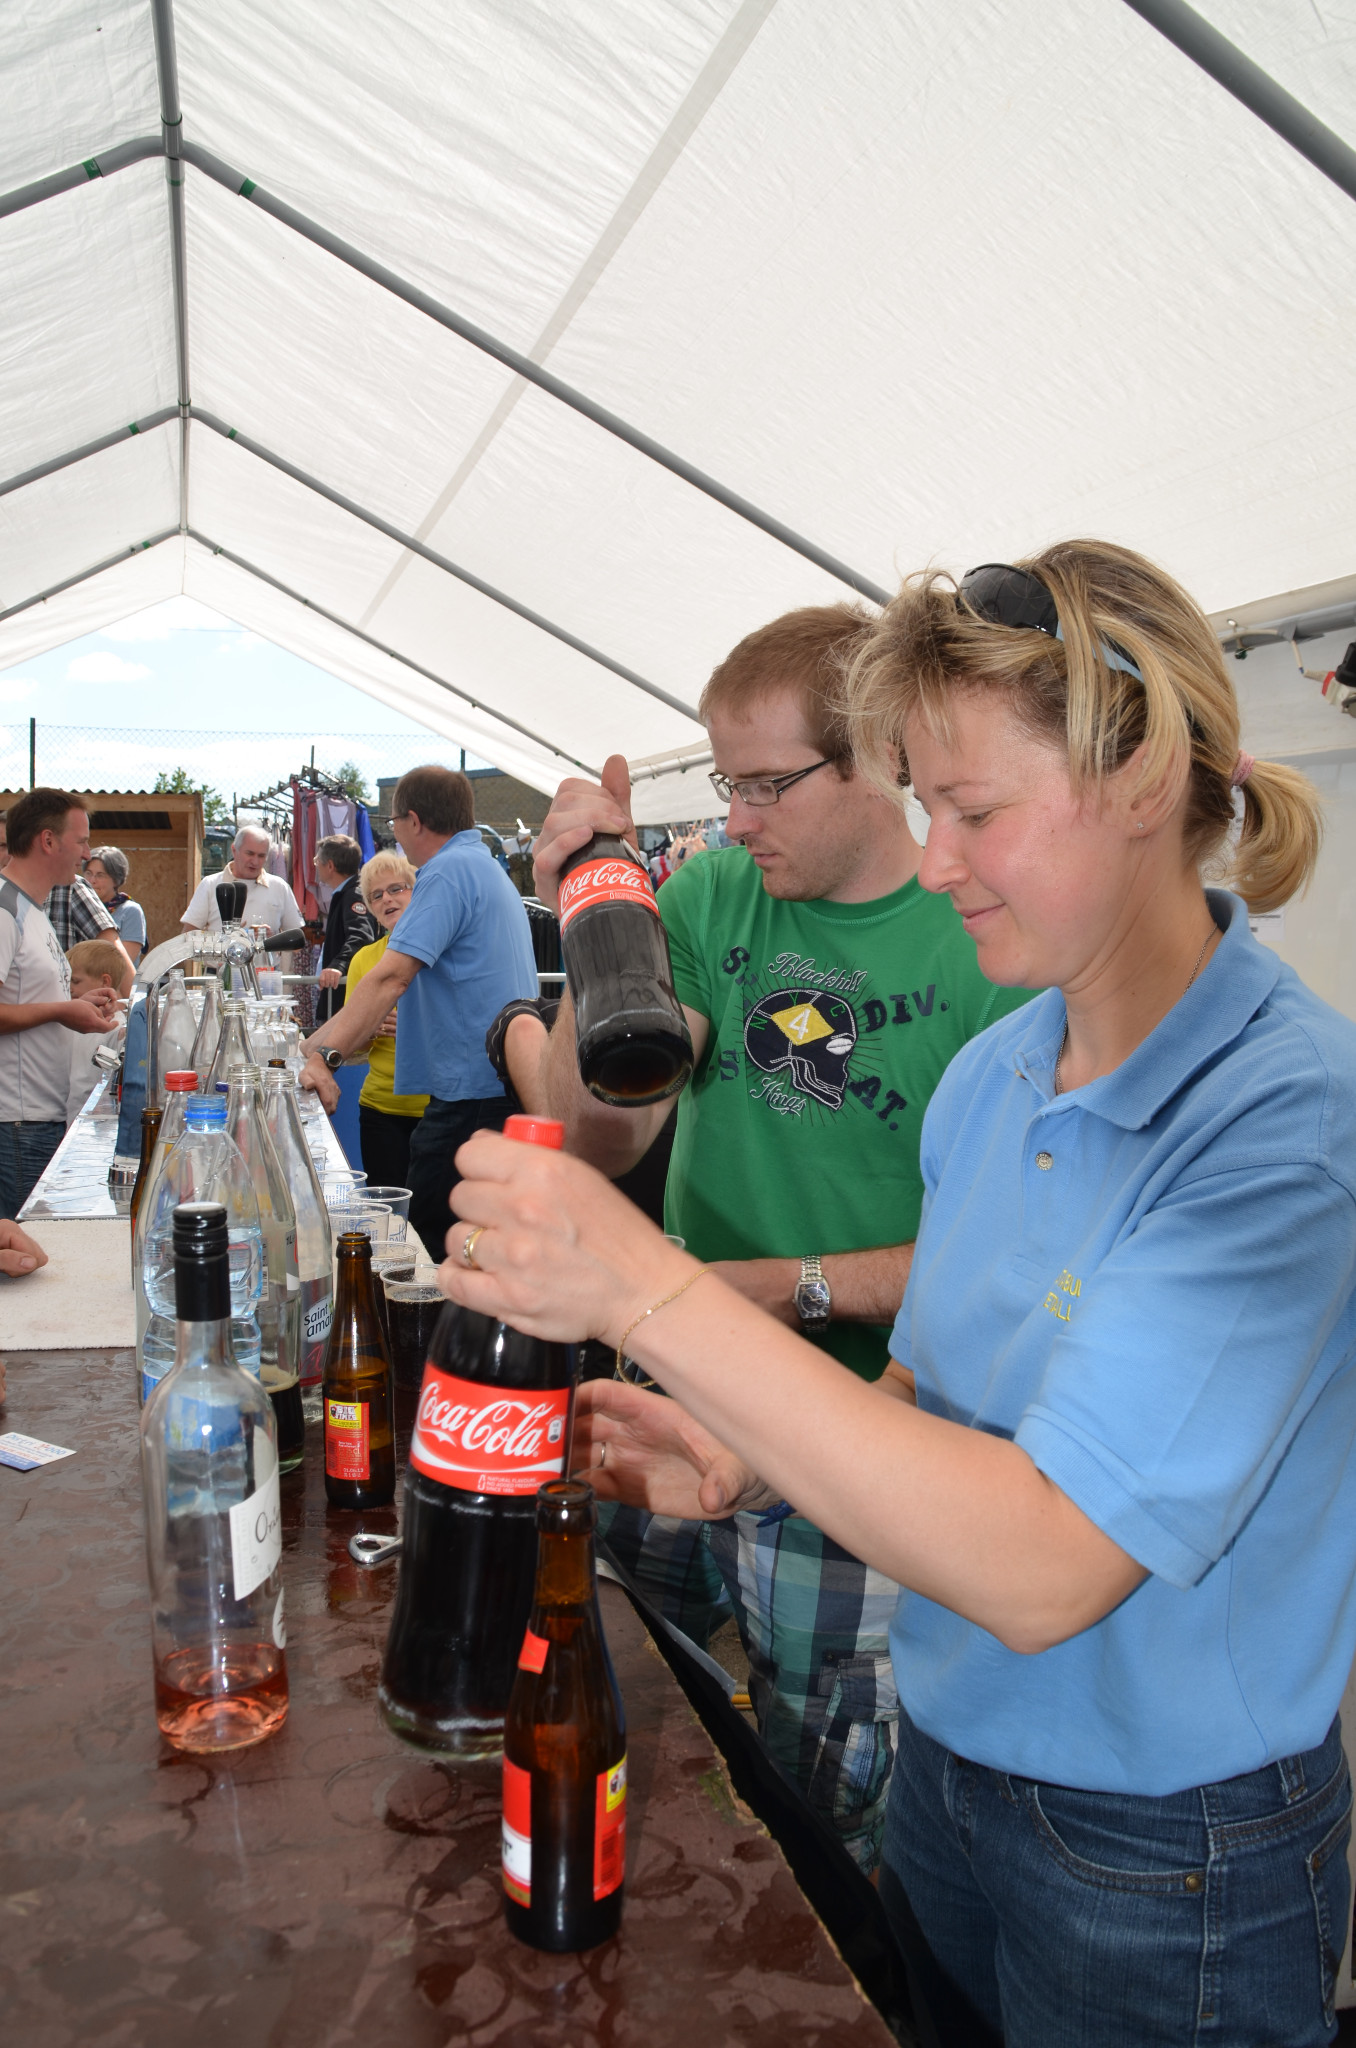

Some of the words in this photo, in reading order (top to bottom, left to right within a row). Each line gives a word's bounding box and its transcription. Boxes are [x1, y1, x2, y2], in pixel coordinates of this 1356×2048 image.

[561, 862, 644, 914] Coca-Cola
[768, 952, 868, 992] Blackhill
[788, 1008, 811, 1039] 4
[862, 984, 950, 1032] DIV.
[749, 1077, 807, 1116] Kings
[850, 1076, 908, 1131] AT.
[304, 1303, 329, 1326] saint
[416, 1381, 556, 1458] Coca-Cola
